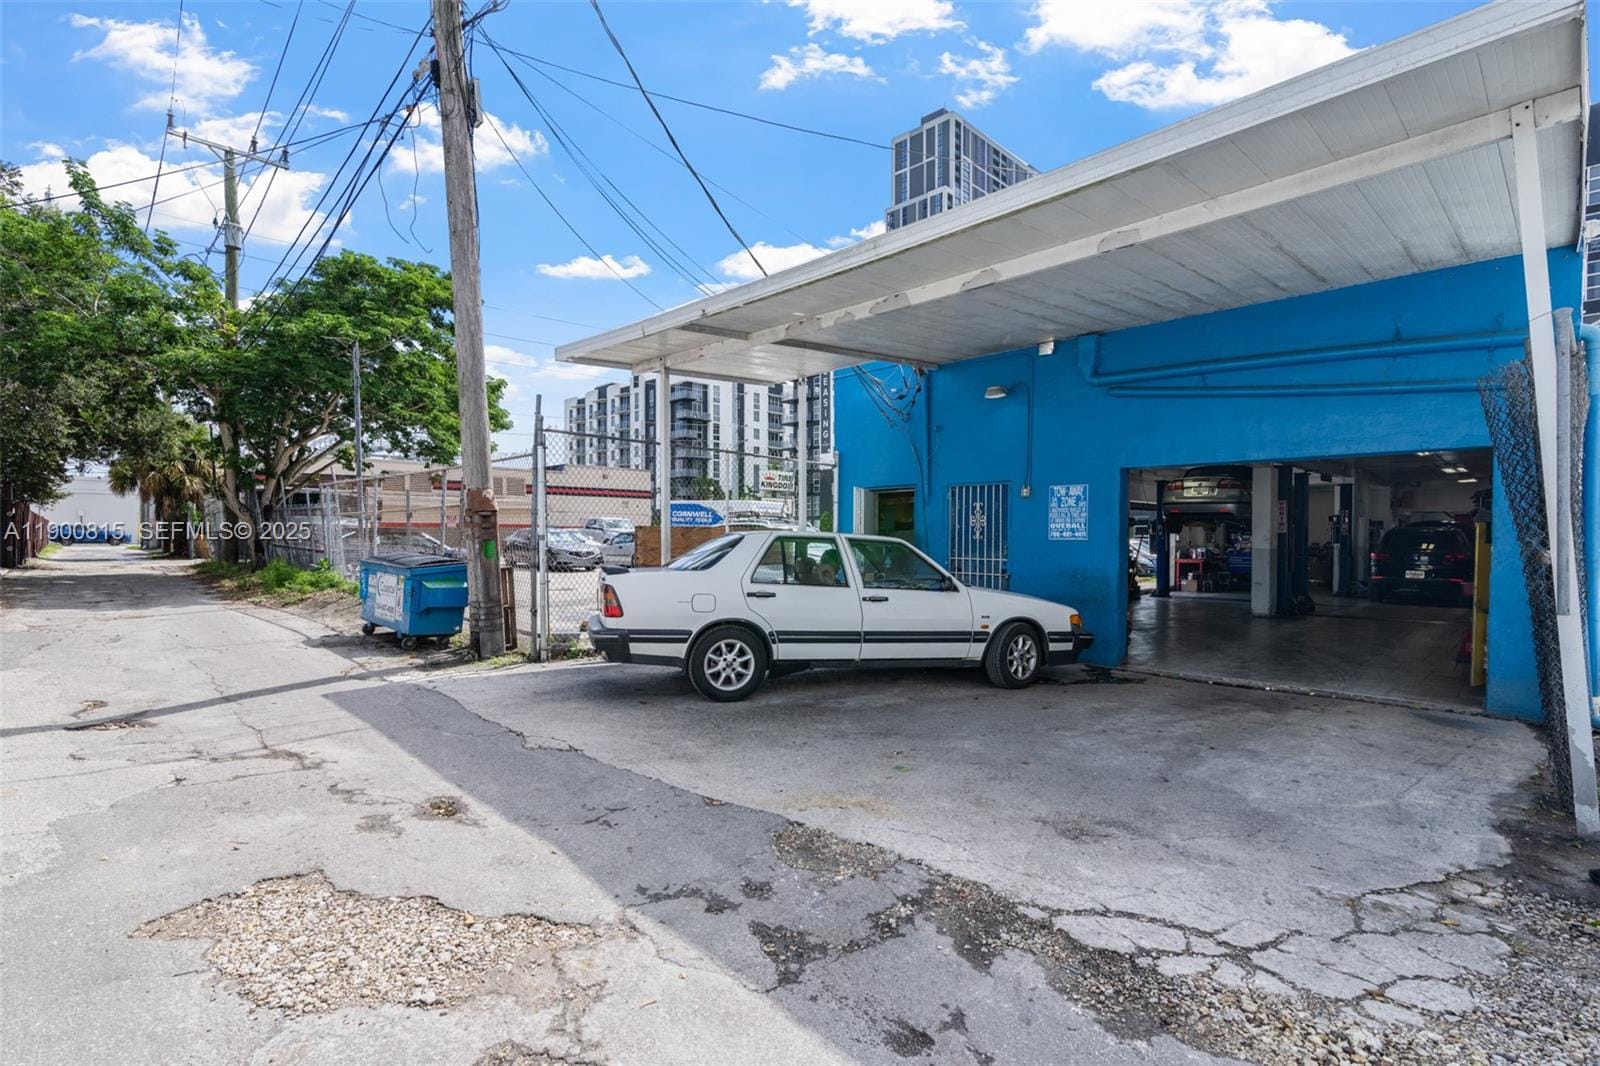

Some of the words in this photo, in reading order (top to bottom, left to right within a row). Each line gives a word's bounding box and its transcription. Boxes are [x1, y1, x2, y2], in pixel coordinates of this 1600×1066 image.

[778, 474, 793, 482] TIRE
[1060, 496, 1077, 507] ZONE
[672, 510, 713, 518] CORNWELL
